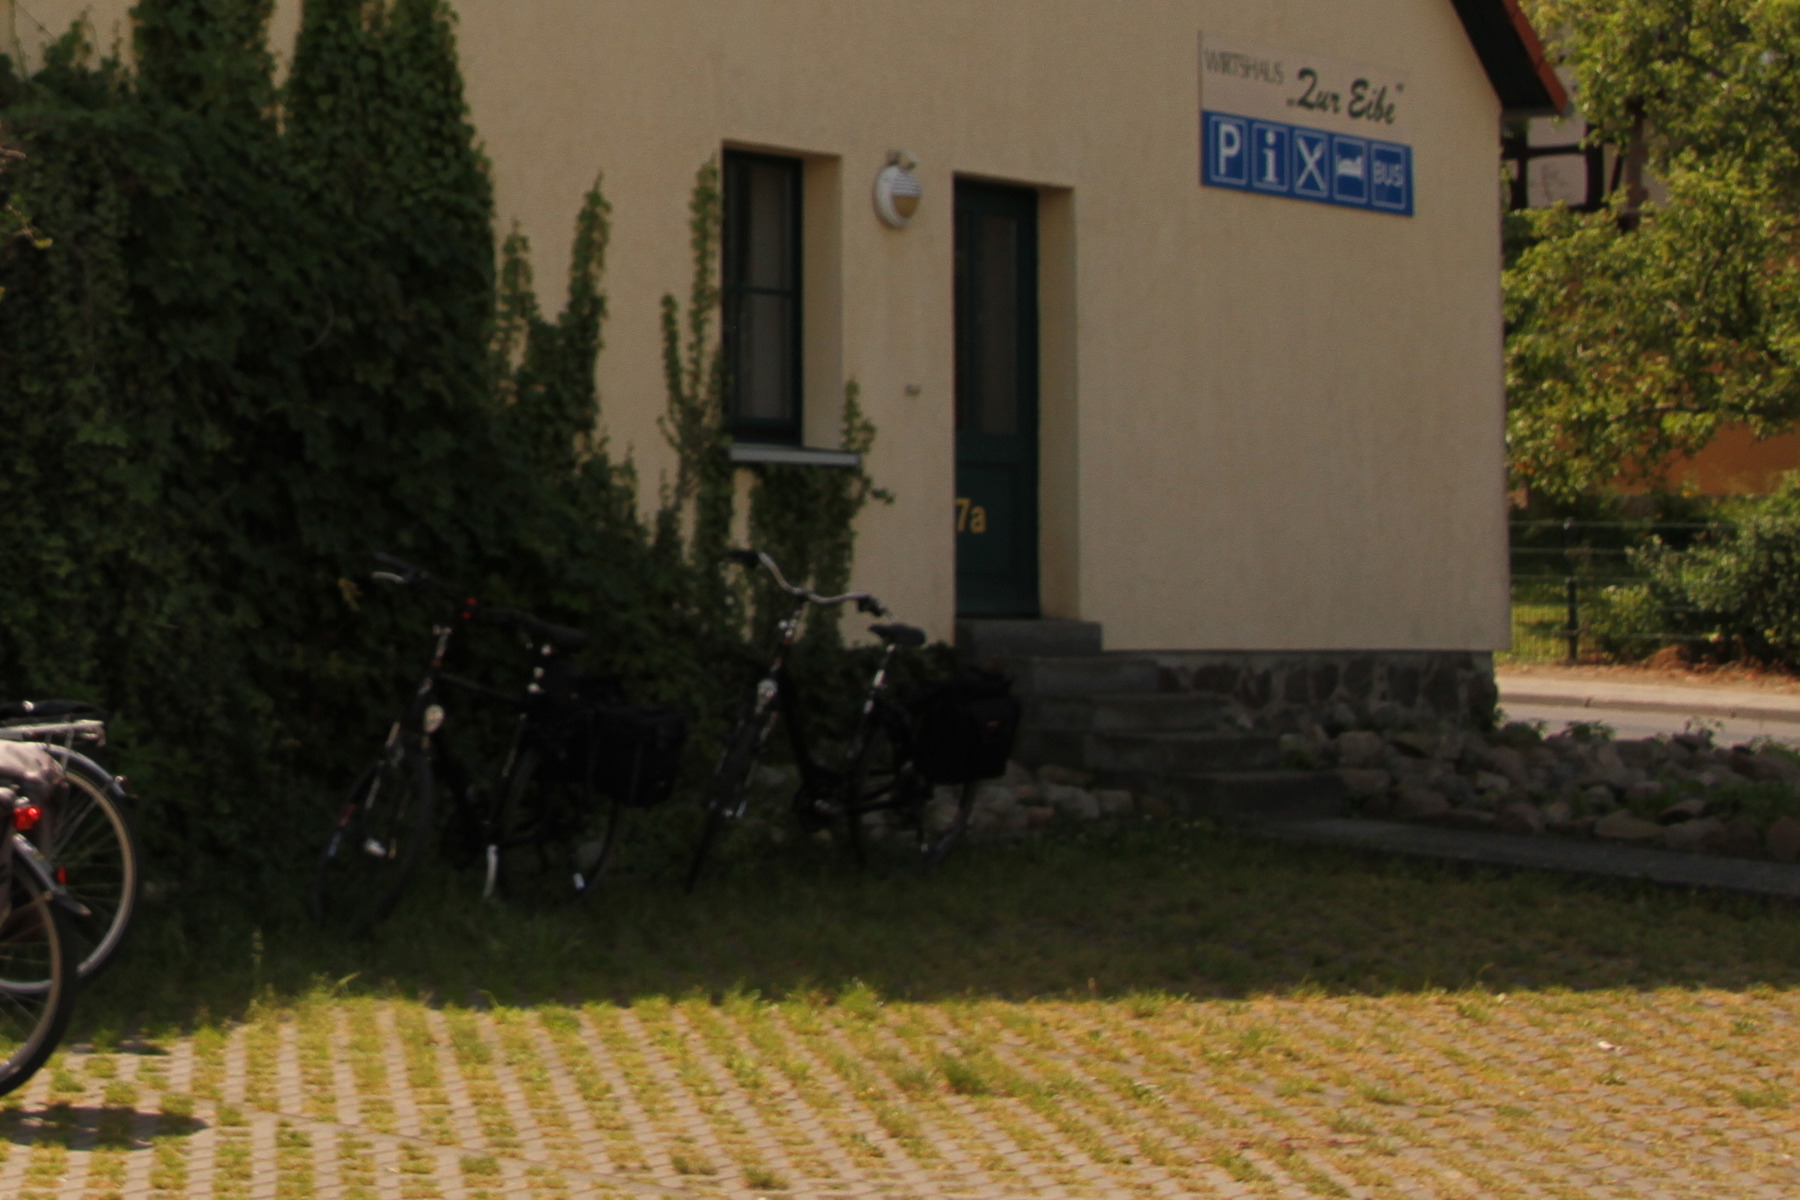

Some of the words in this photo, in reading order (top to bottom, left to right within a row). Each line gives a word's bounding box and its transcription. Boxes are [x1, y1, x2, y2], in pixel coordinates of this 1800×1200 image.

[1219, 124, 1241, 175] P
[1263, 131, 1279, 182] i
[1373, 161, 1404, 187] BUS
[955, 498, 986, 533] 7a
